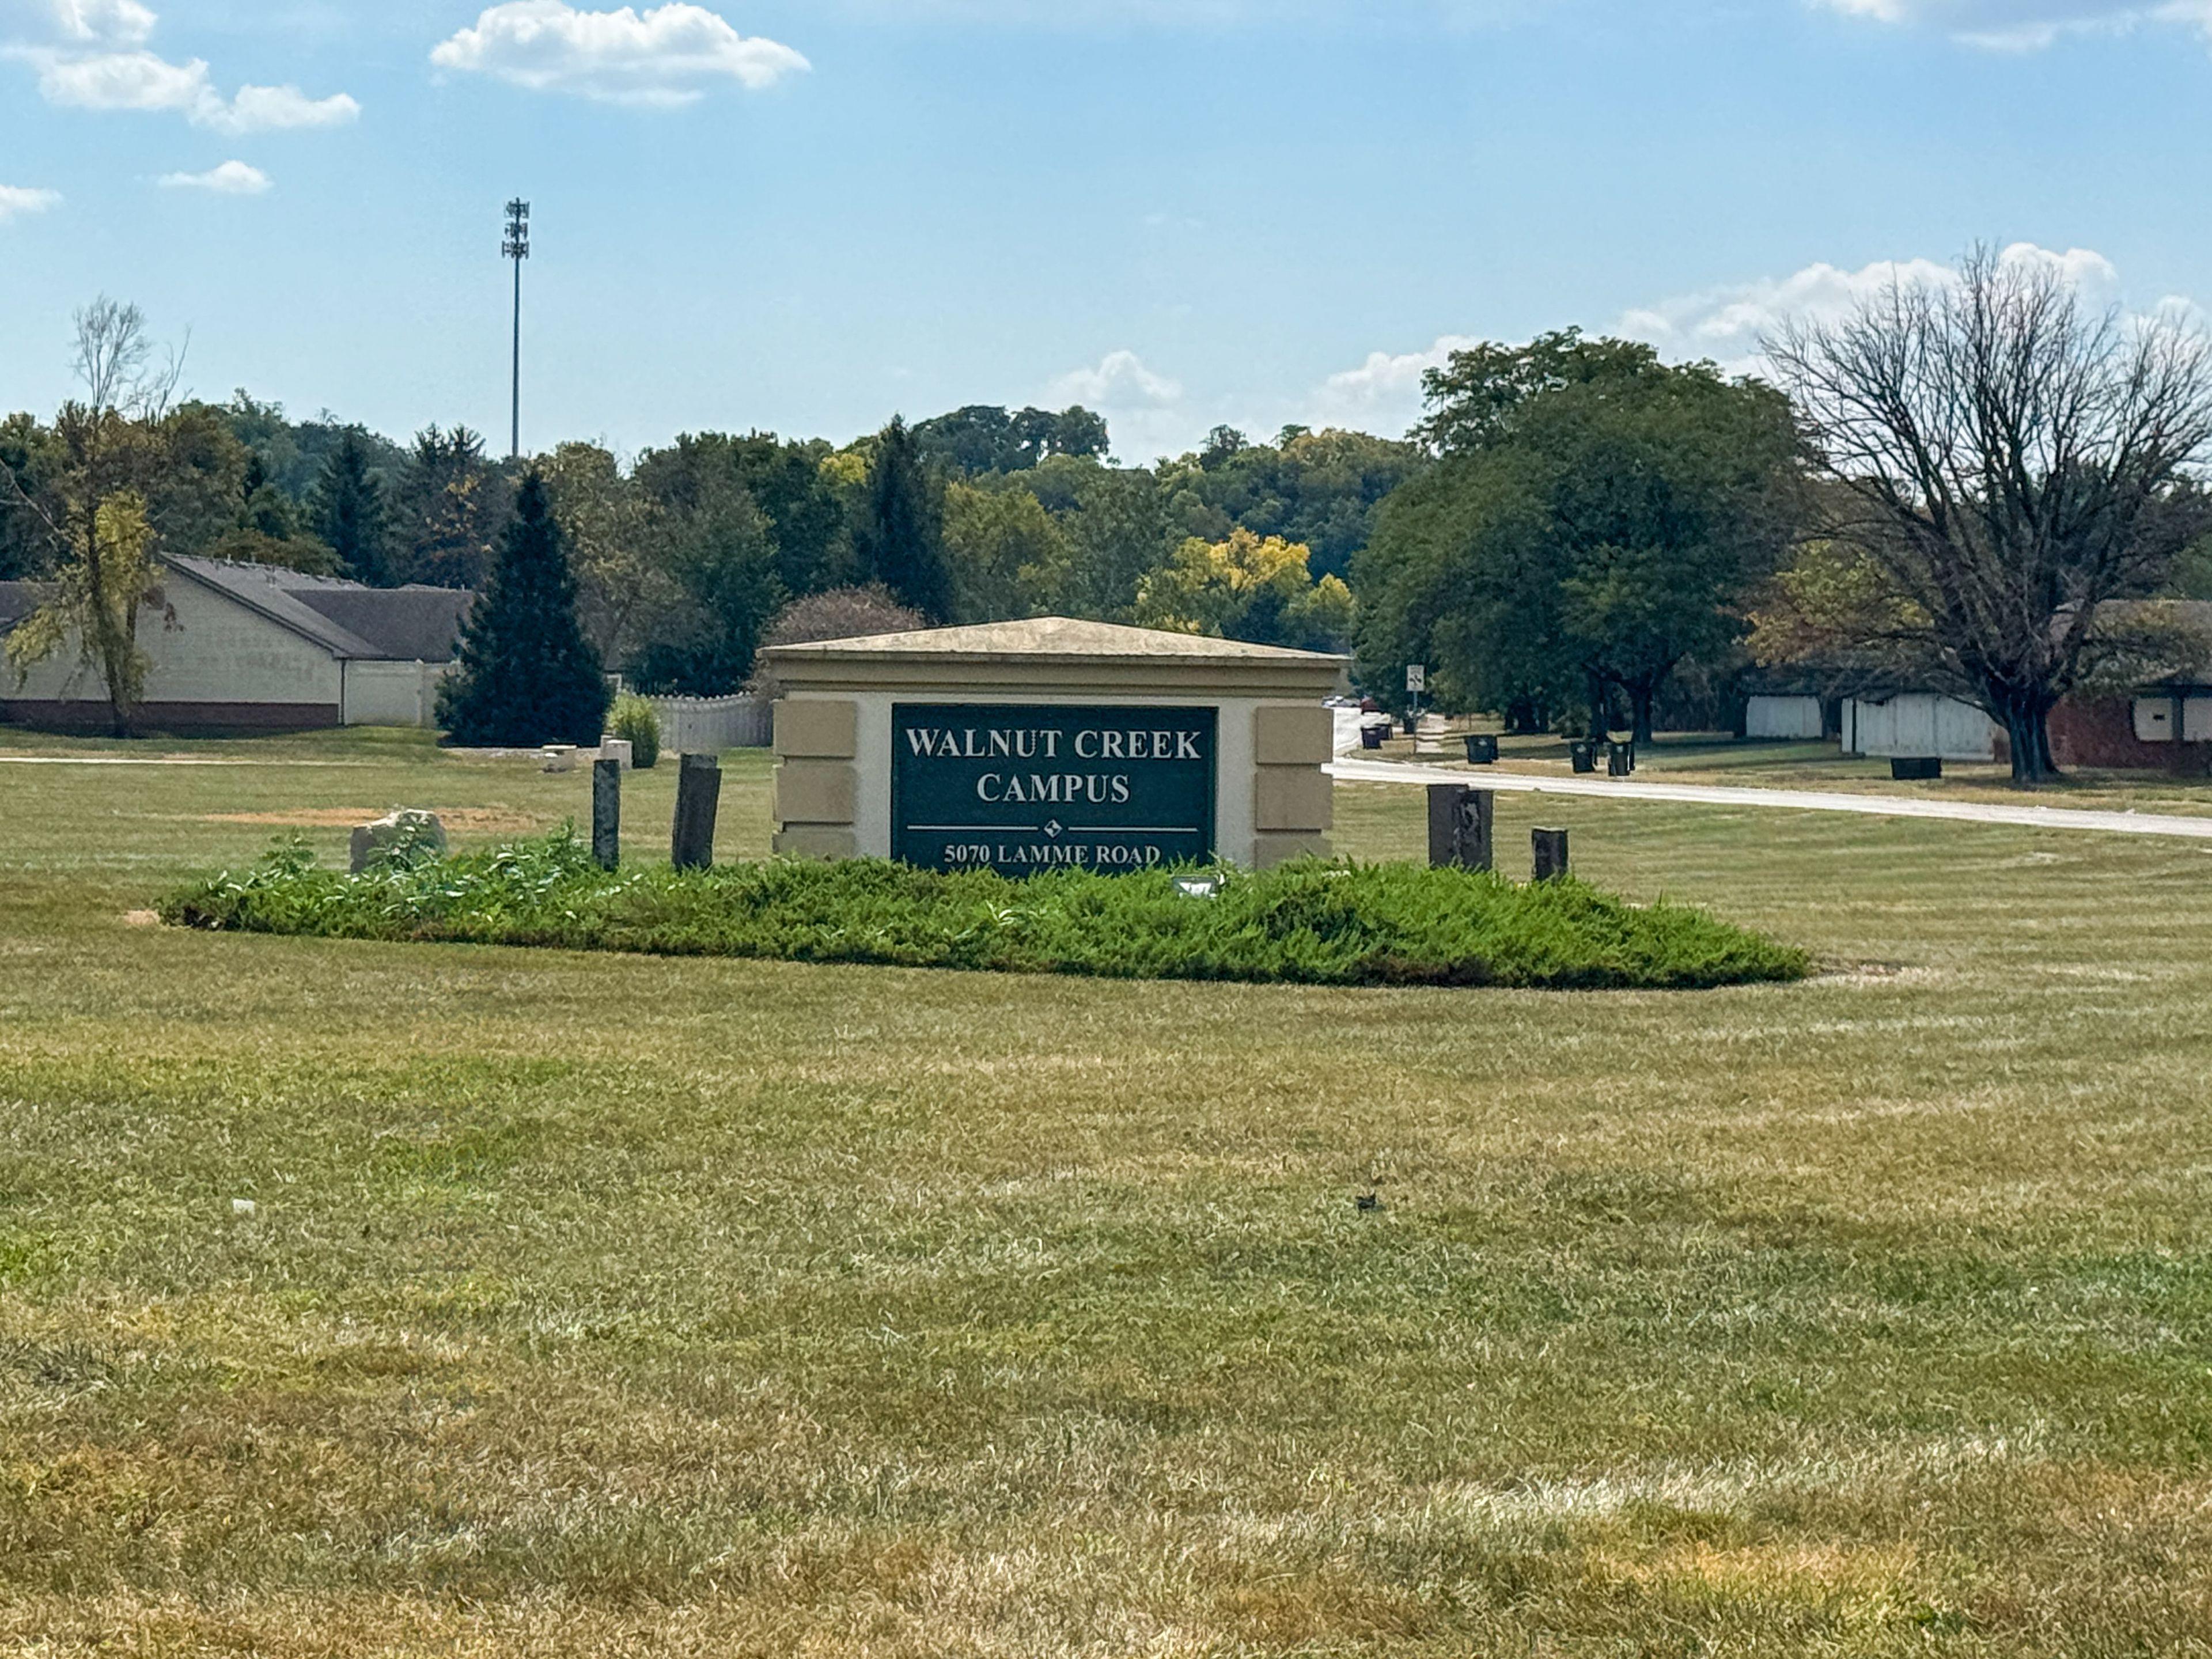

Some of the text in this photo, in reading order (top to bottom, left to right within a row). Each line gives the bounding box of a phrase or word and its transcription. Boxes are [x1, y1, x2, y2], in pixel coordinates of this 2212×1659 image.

[906, 728, 1202, 760] WALNUT CREEK
[977, 773, 1130, 803] CAMPUS
[944, 845, 1161, 864] 5070 LAMME ROAD
